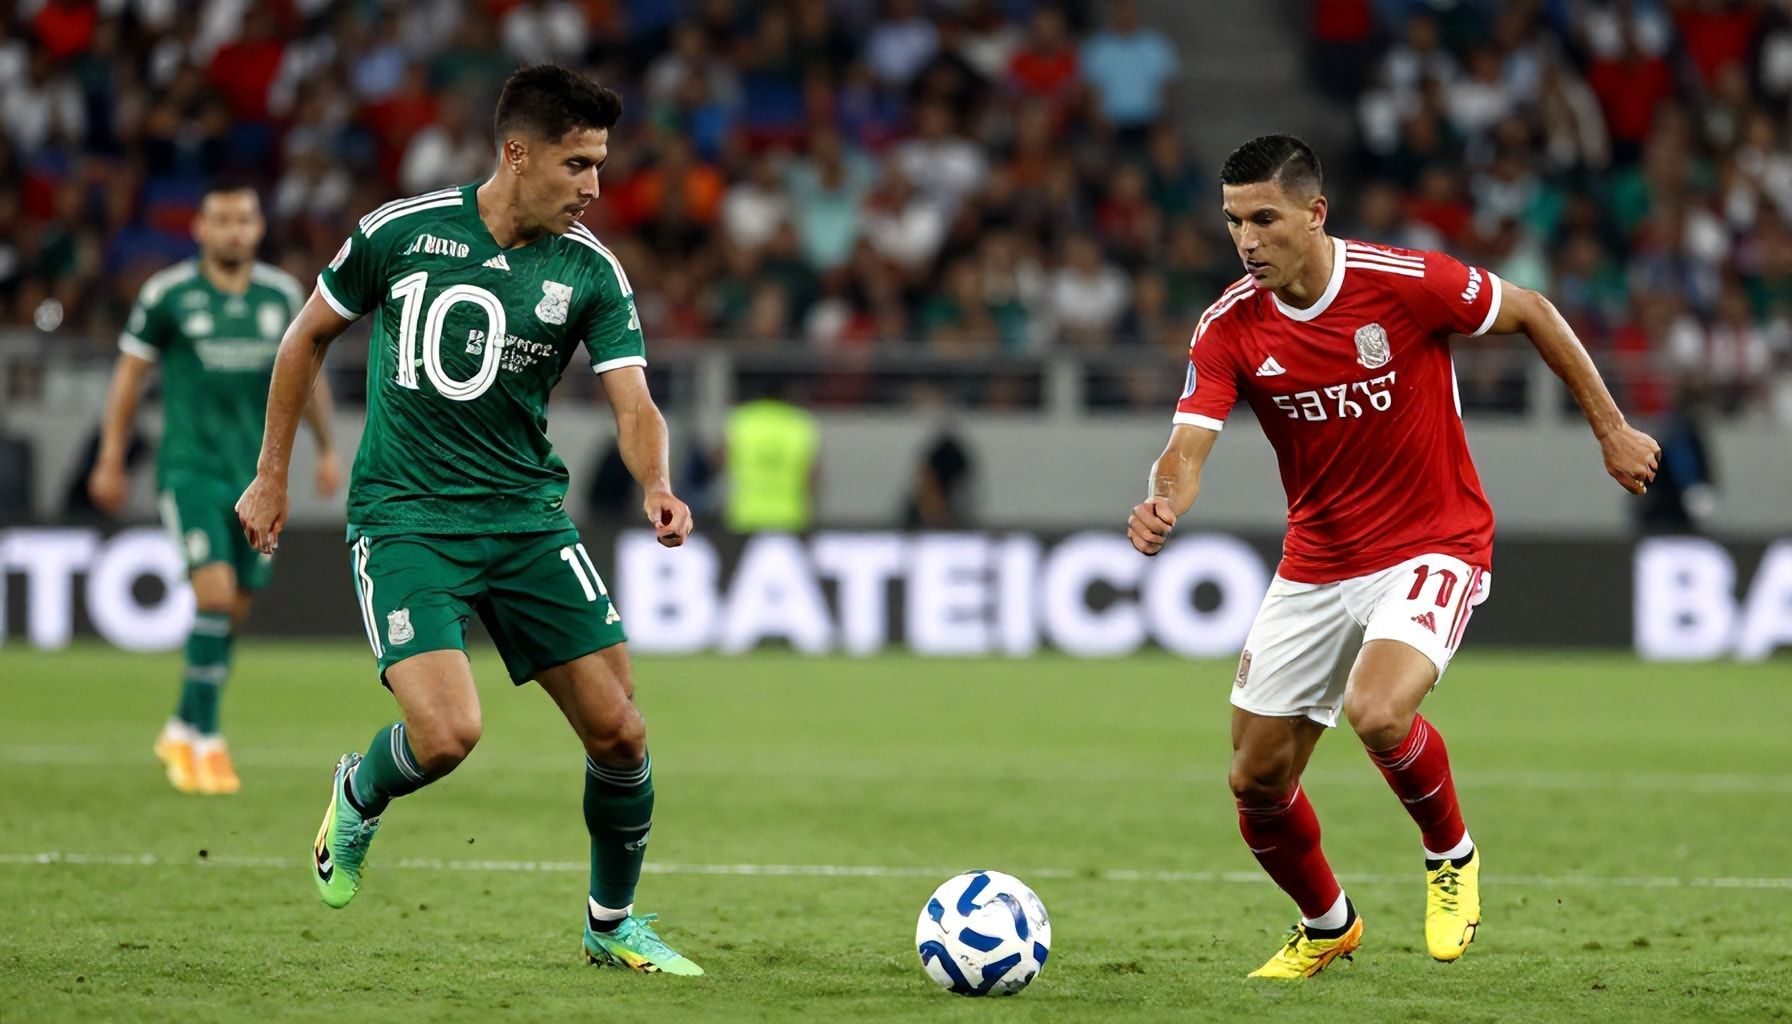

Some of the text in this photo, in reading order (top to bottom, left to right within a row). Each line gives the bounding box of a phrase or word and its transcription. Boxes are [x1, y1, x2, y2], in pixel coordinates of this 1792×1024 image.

[391, 271, 506, 401] 10
[0, 528, 195, 651] TO
[616, 530, 1267, 657] BATEICO
